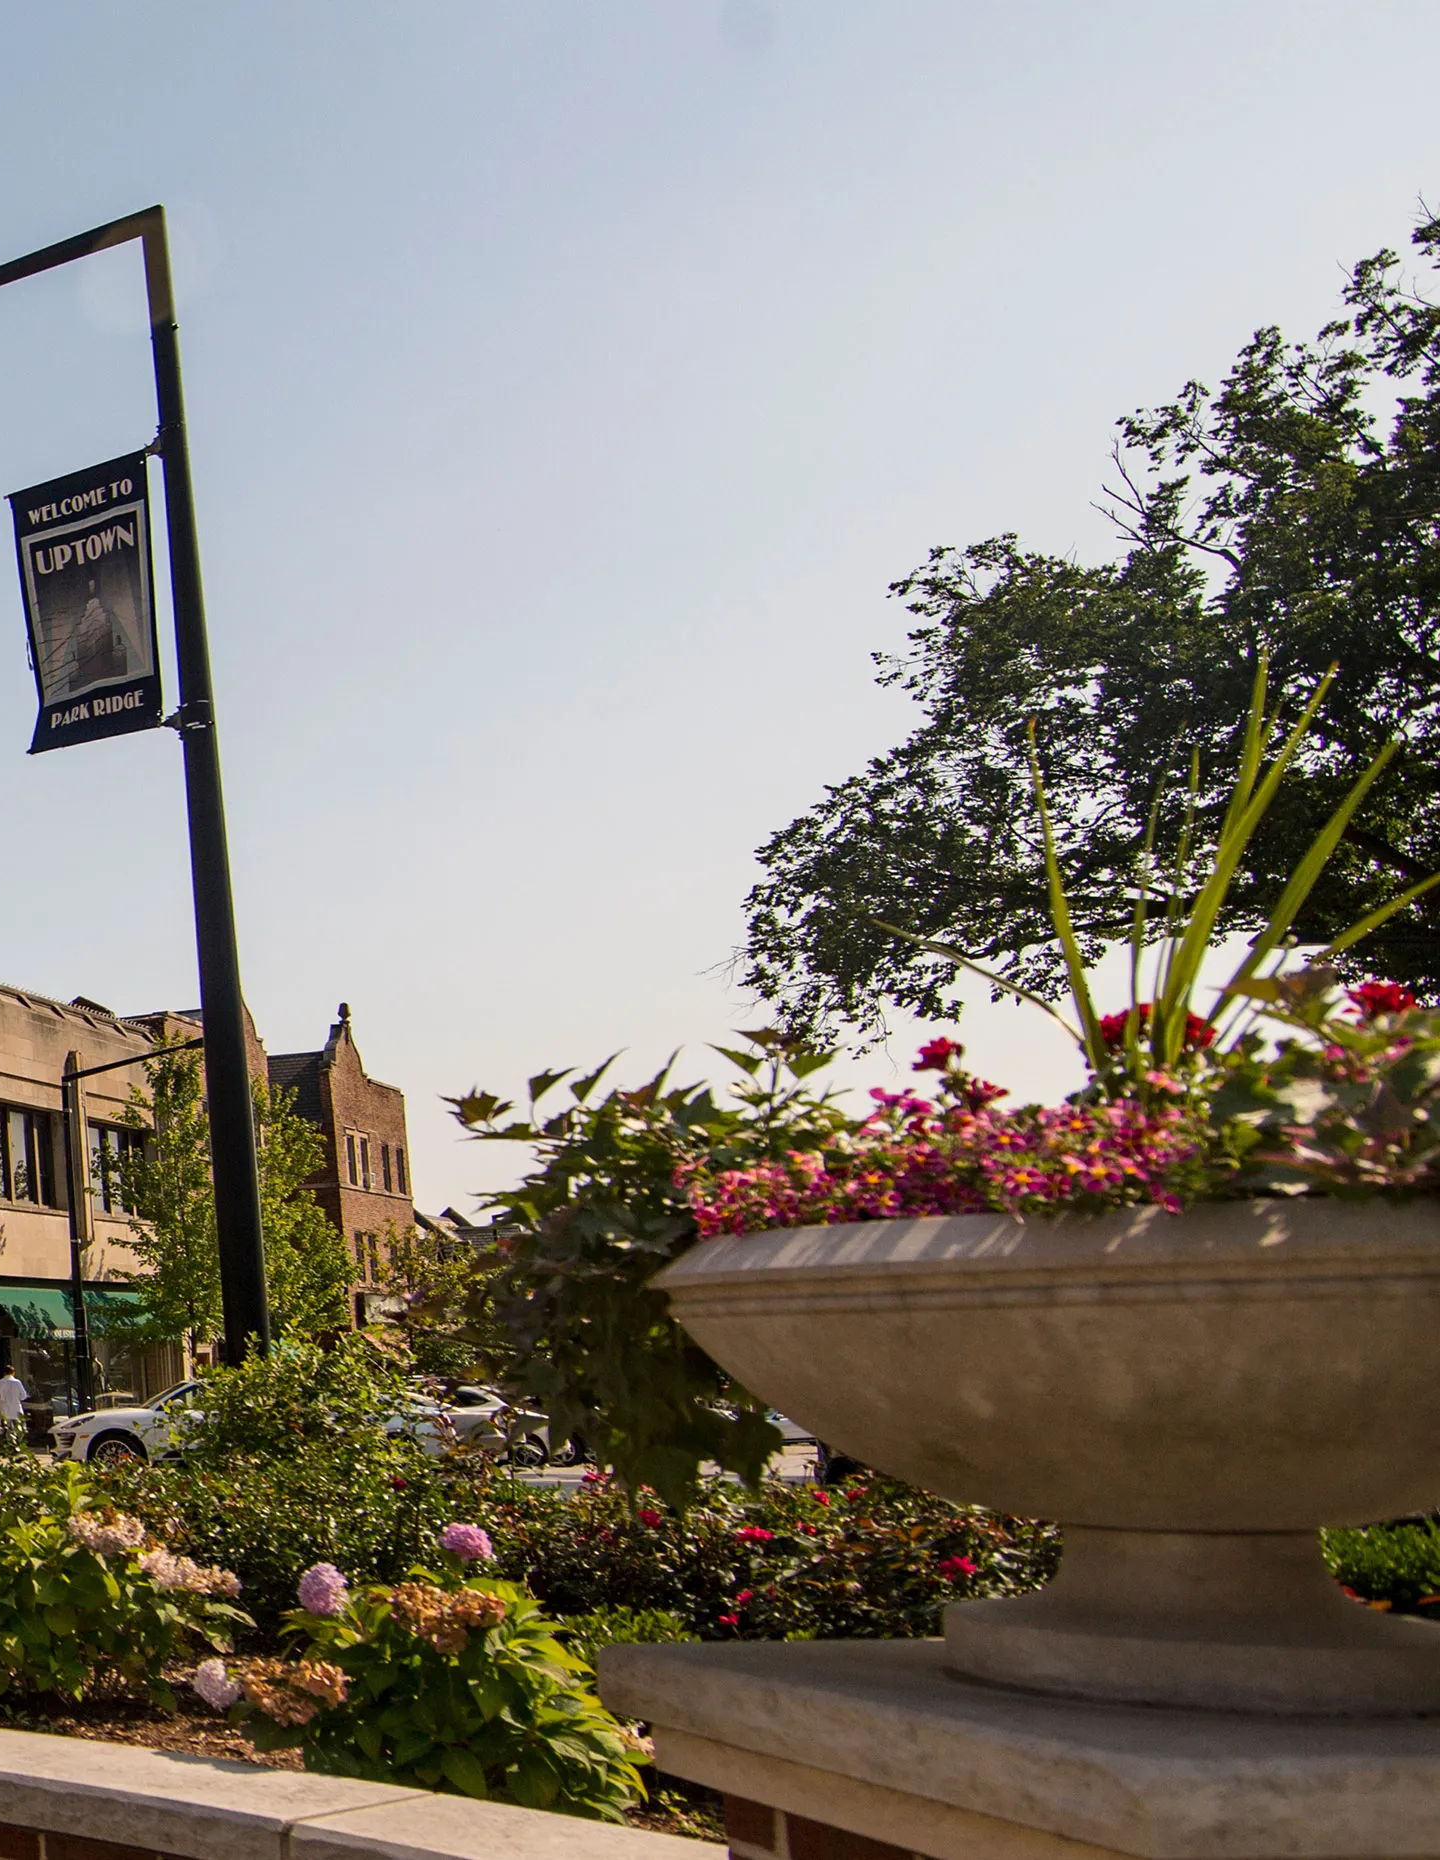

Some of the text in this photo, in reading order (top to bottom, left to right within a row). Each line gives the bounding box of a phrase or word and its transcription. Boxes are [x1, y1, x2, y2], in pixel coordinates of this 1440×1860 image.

[28, 478, 133, 526] WELCOME TO
[36, 522, 135, 576] UPTOWN
[51, 689, 145, 729] PARK RIDGE
